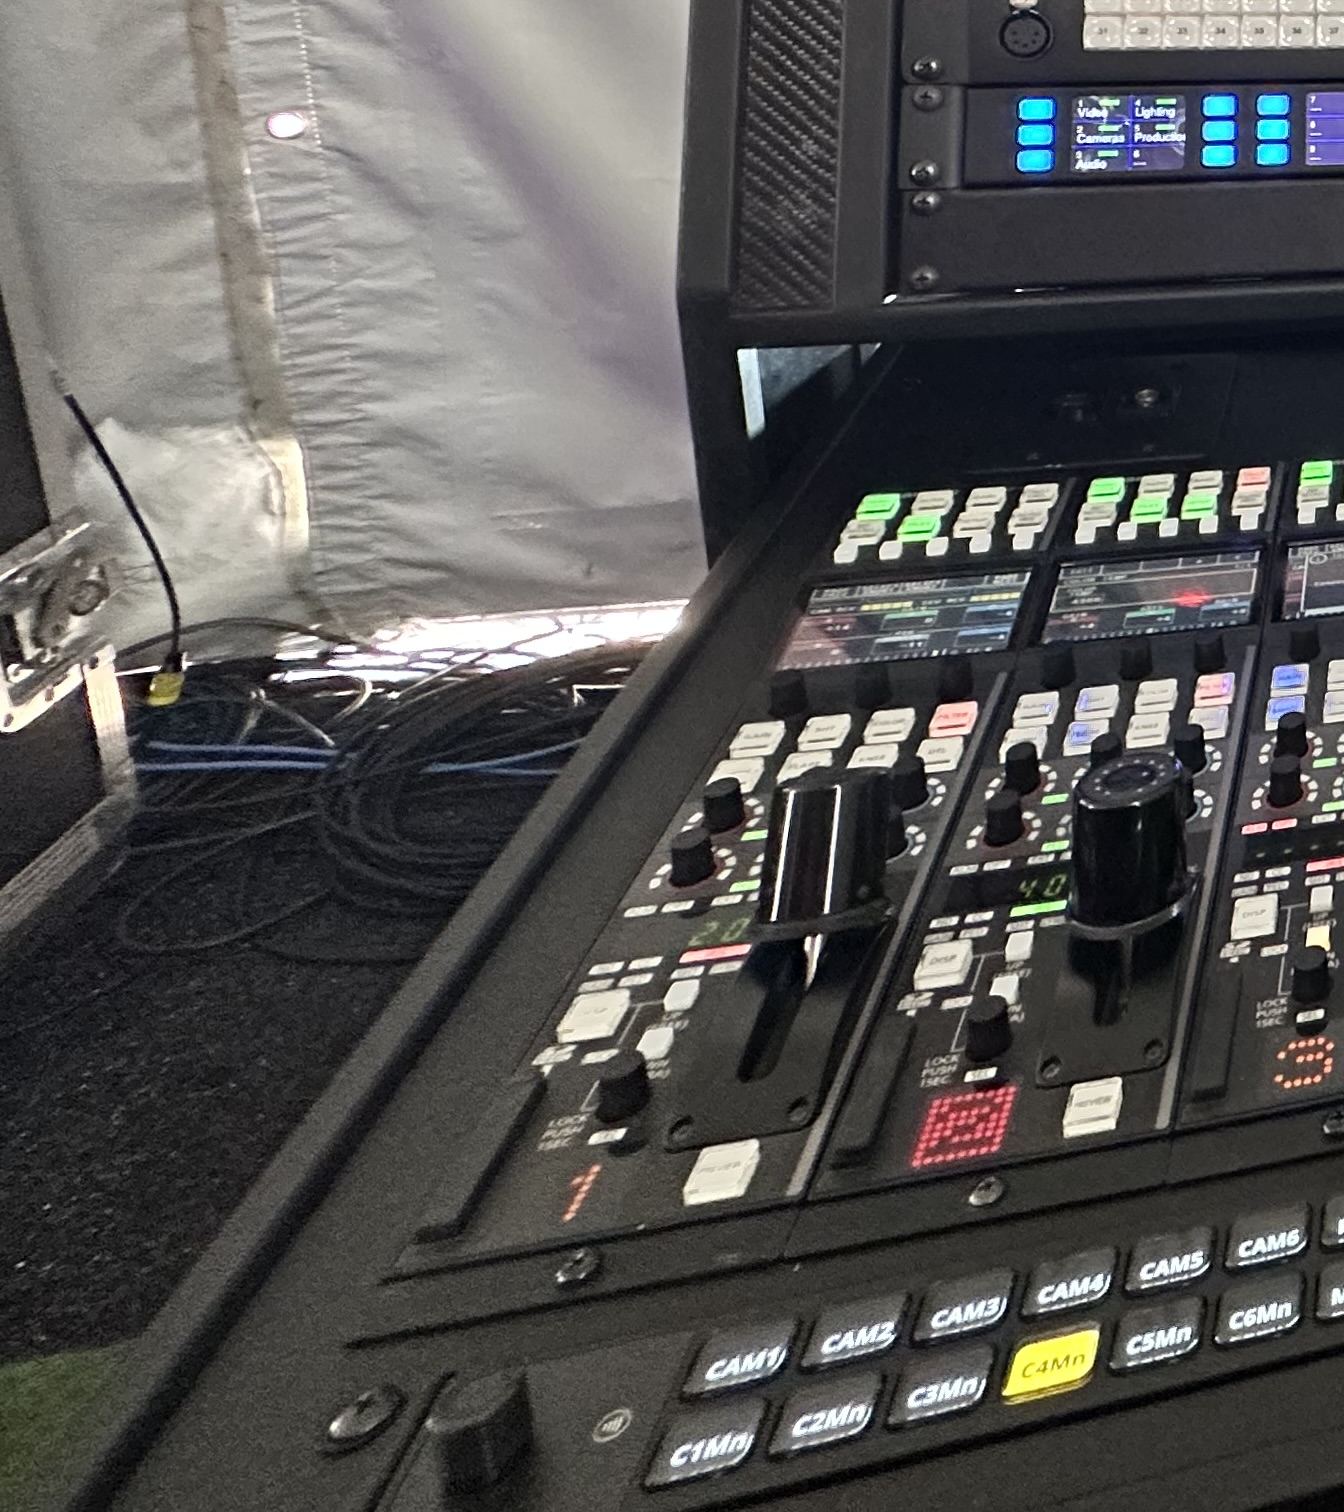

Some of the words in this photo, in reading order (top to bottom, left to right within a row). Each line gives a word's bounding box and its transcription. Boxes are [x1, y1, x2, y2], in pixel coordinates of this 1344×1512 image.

[1077, 107, 1108, 119] Video
[1135, 107, 1176, 119] Lighting
[1310, 95, 1316, 103] 7
[1076, 134, 1125, 144] Cameras
[1075, 159, 1107, 171] Audio
[1242, 908, 1268, 919] DISP
[929, 953, 958, 966] DISP
[1256, 997, 1288, 1010] LOCK
[1256, 1007, 1288, 1019] PUSH
[921, 1065, 958, 1079] PUSH
[923, 1053, 961, 1068] LOCK
[1273, 1036, 1335, 1090] 3
[561, 1163, 603, 1223] 1
[1239, 1228, 1300, 1258] CAM6
[1140, 1251, 1204, 1281] CAM5
[1037, 1273, 1105, 1304] CAM4
[930, 1296, 1001, 1329] CAM3
[1229, 1301, 1293, 1330] C6Mn
[820, 1321, 896, 1356] CAM2
[1126, 1325, 1192, 1355] C5Mn
[705, 1346, 780, 1382] CAM1
[1021, 1352, 1087, 1381] C4Mn
[906, 1376, 978, 1409] C3Mn
[791, 1403, 866, 1438] C2Mn
[670, 1431, 748, 1468] C1Mn
